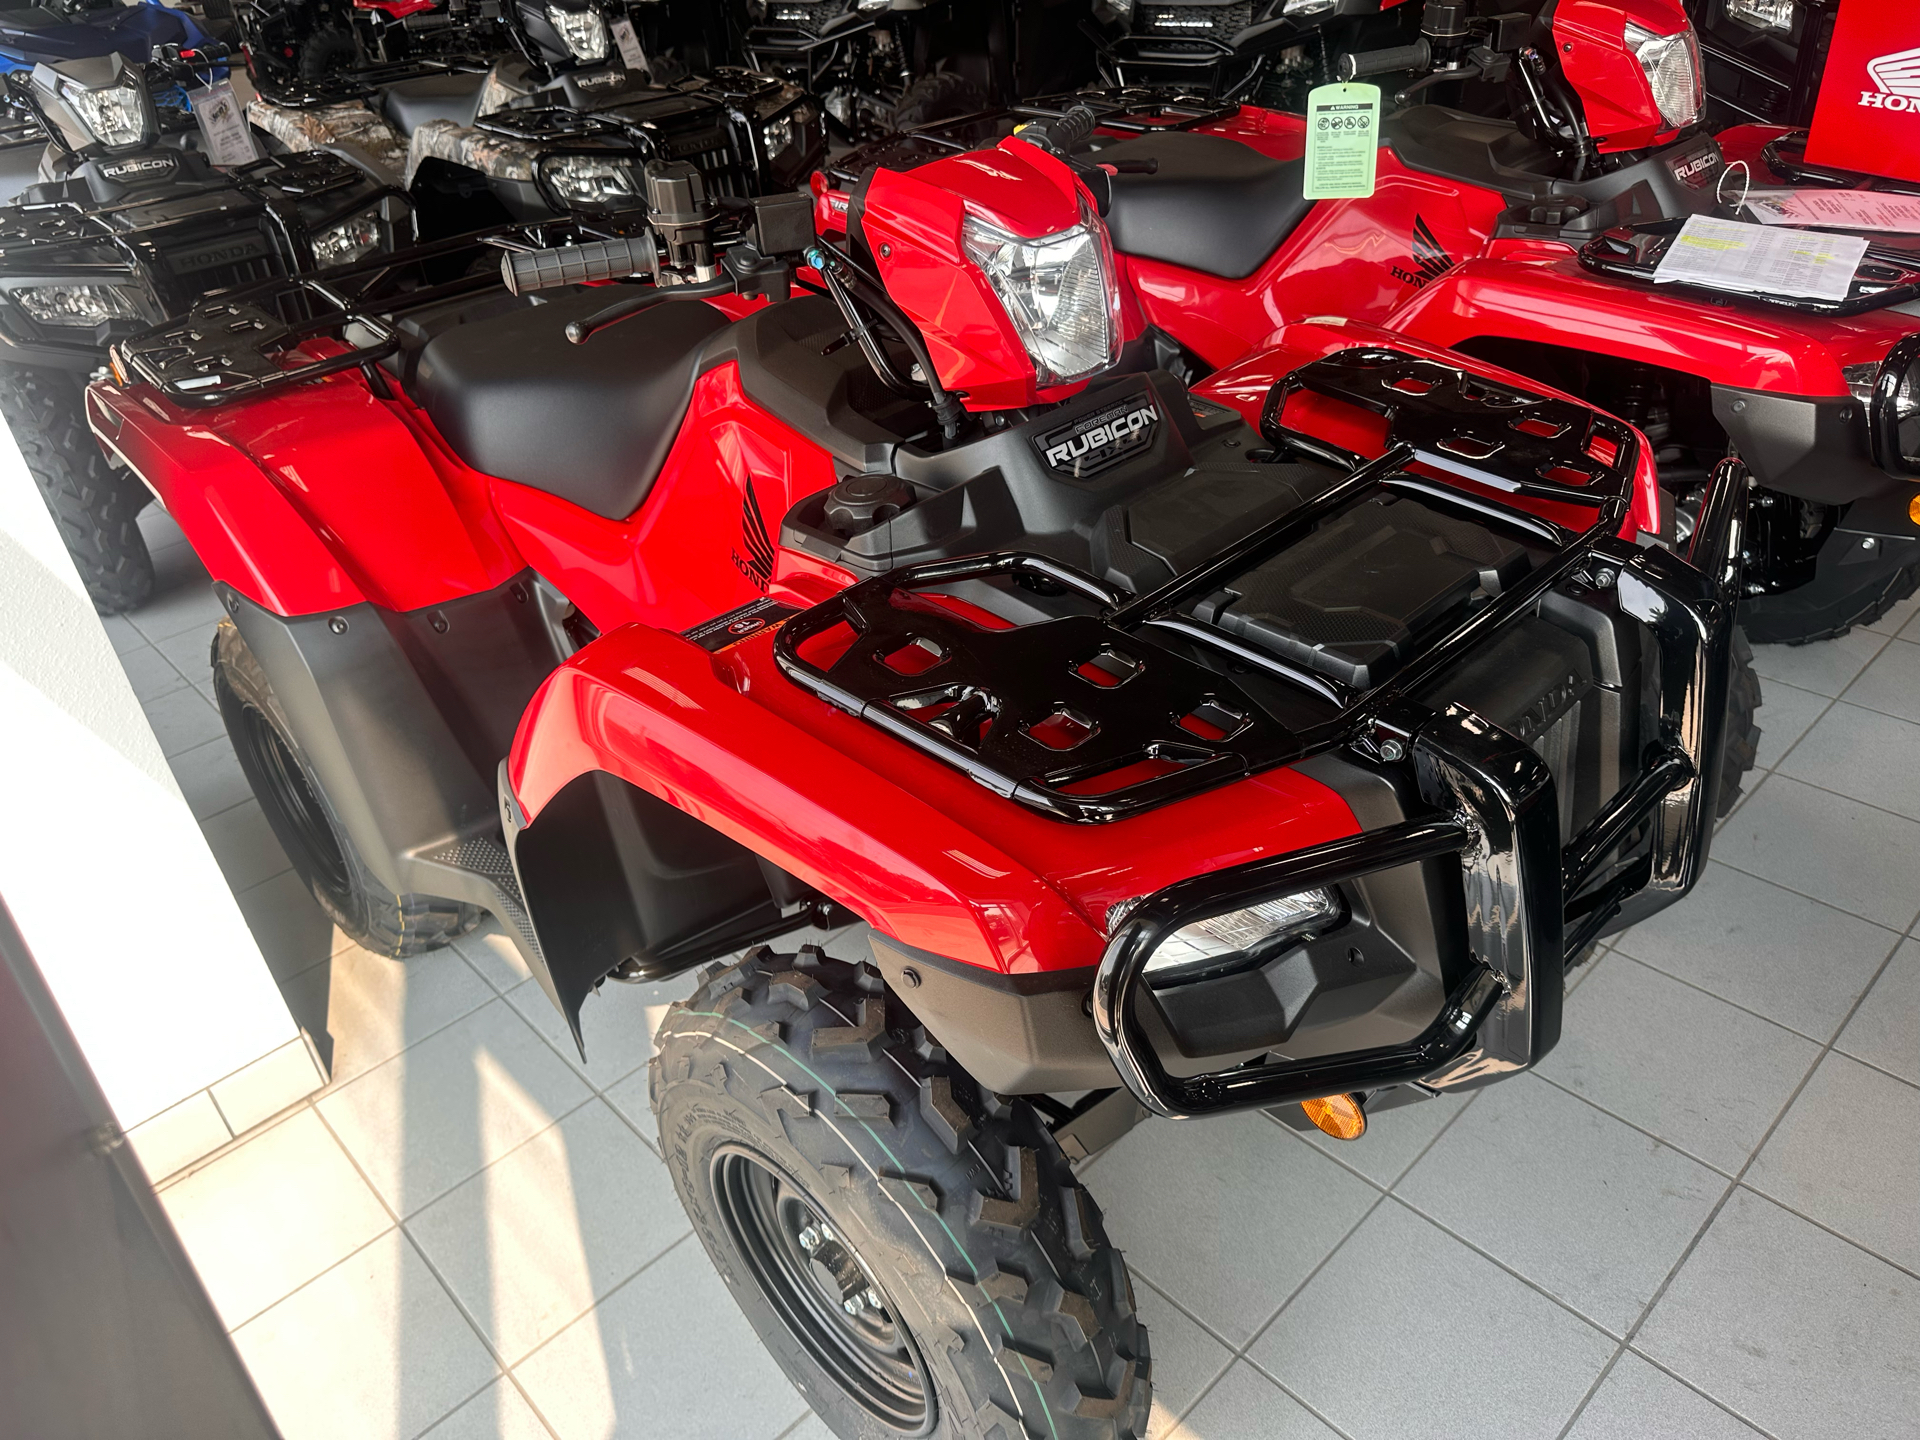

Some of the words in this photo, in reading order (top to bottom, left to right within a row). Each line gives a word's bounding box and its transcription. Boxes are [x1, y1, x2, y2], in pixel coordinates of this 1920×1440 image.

[577, 73, 626, 88] RUBICON
[103, 158, 175, 178] RUBICON
[1674, 152, 1719, 181] RUBICON
[181, 242, 260, 268] HONDA
[1074, 405, 1129, 434] FOREMAN
[1045, 404, 1159, 468] RUBICON
[734, 620, 751, 629] 16
[1507, 667, 1589, 738] ONDA
